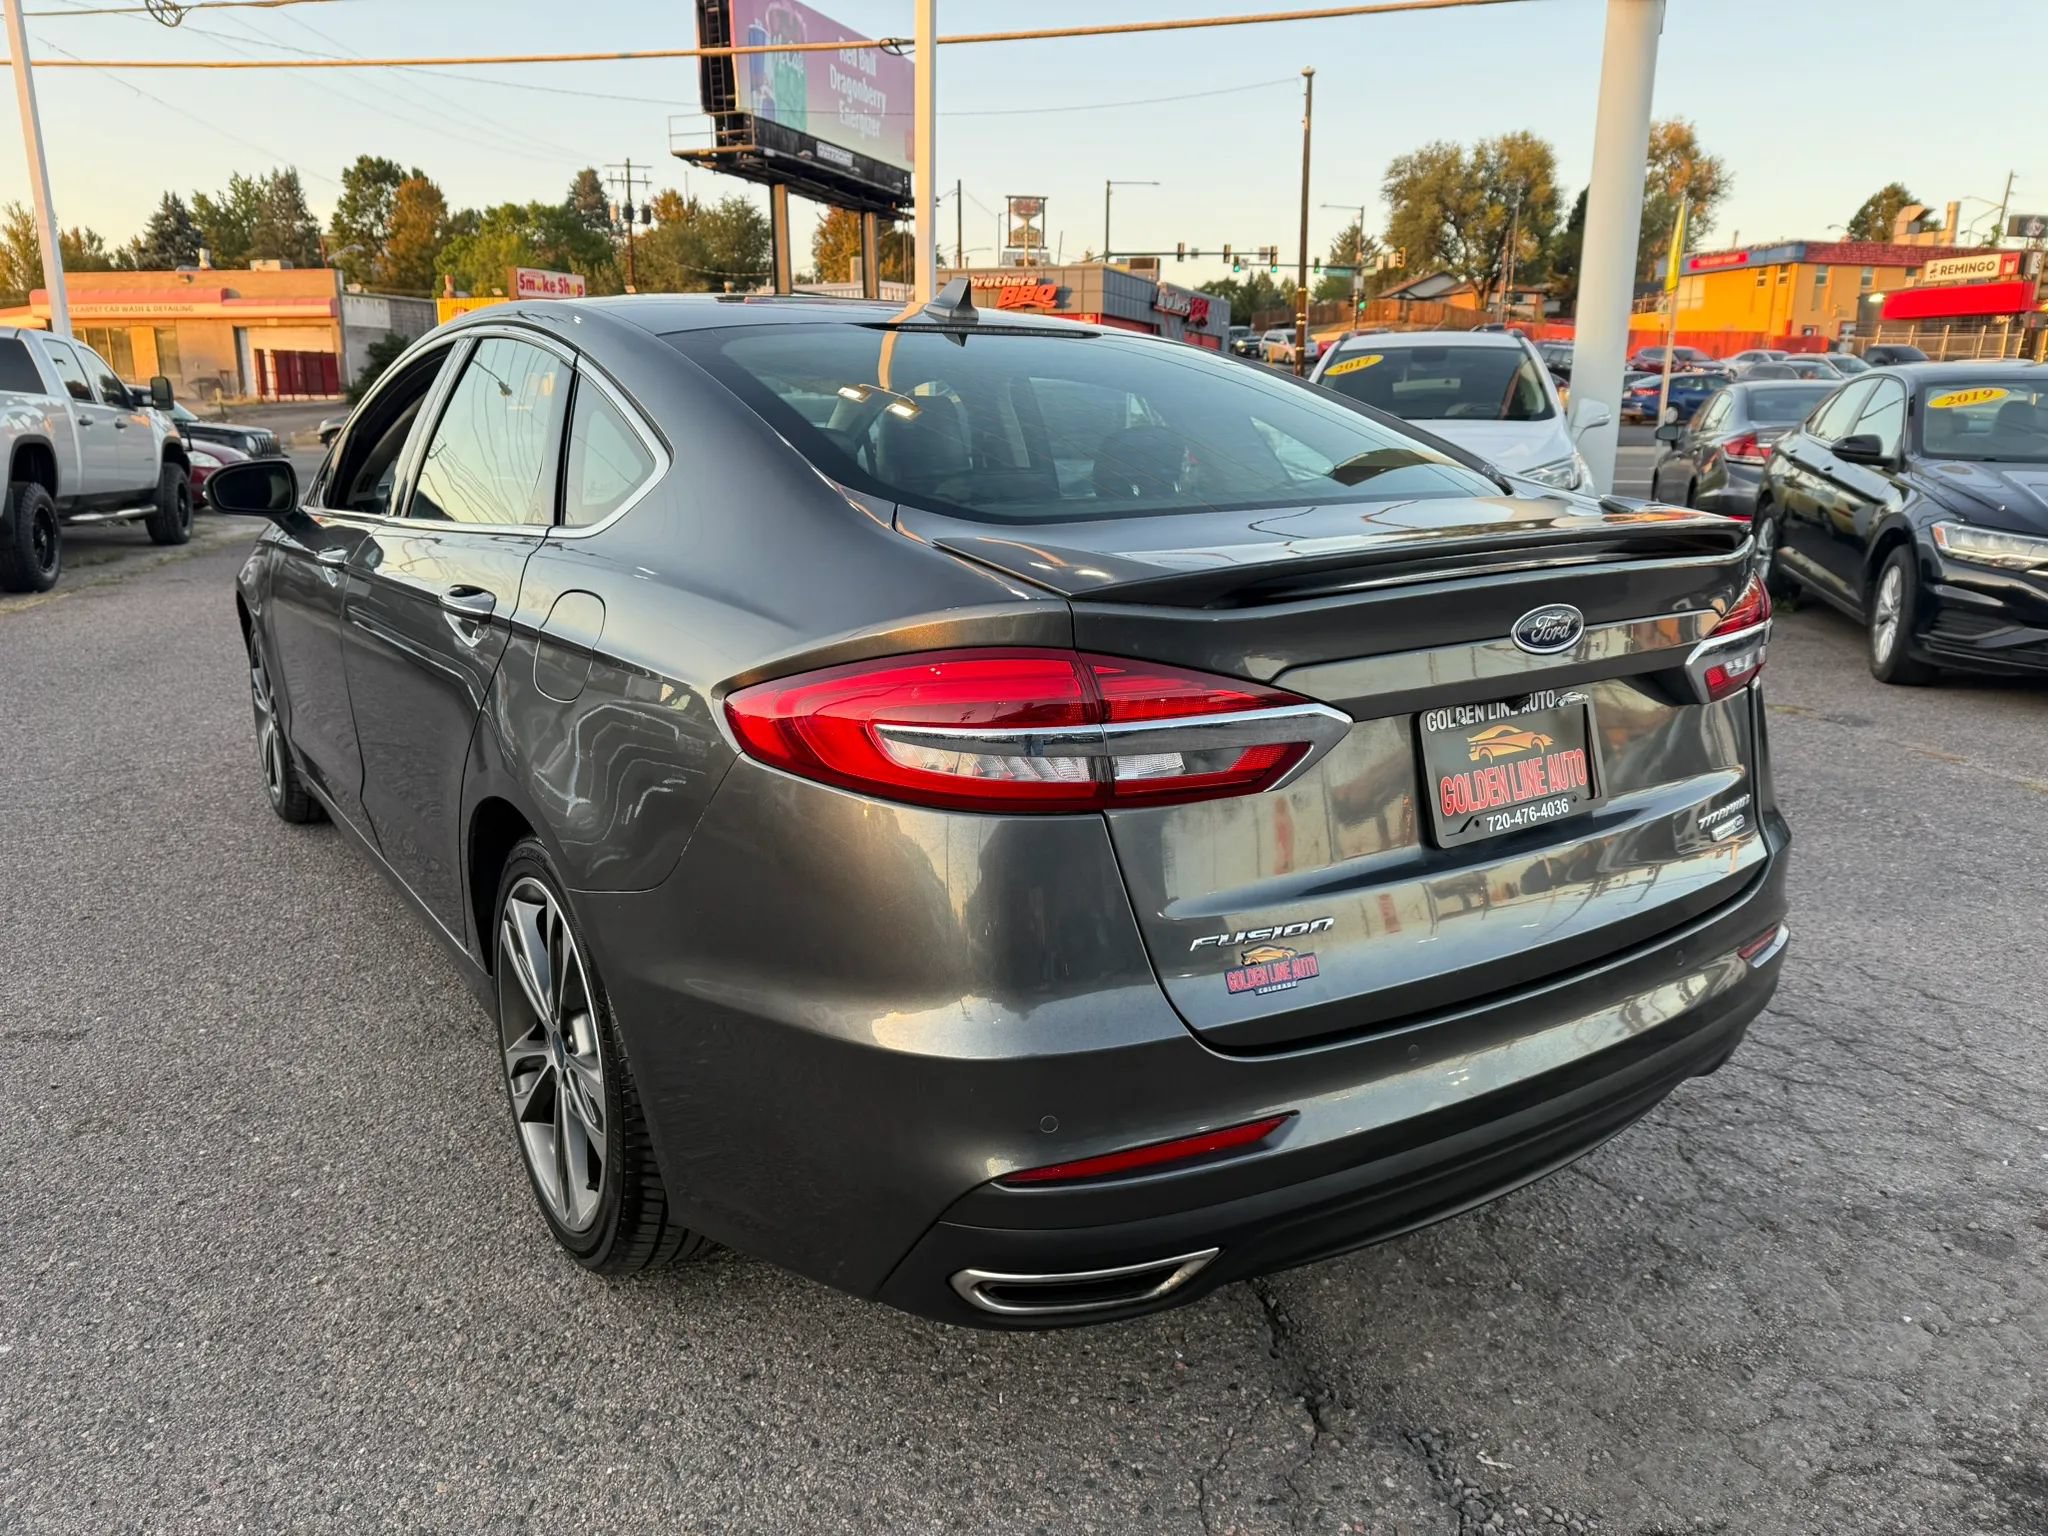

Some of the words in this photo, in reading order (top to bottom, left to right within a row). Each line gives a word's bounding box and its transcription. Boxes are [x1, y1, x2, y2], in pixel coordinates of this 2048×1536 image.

[829, 63, 887, 117] Dragonberry
[1939, 260, 1996, 276] REMINGO
[519, 272, 556, 294] Smoke
[558, 276, 584, 297] Shop
[996, 284, 1057, 309] BBQ
[122, 305, 145, 313] WASH
[153, 304, 195, 312] DETAILING
[1337, 356, 1371, 373] 2017
[1944, 389, 1994, 406] 2019
[1530, 614, 1577, 643] Ford
[1440, 762, 1512, 816] GOLDEN
[1509, 756, 1548, 801] LINE
[1547, 748, 1588, 793] AUTO
[1486, 797, 1569, 832] 720-476-4036
[1190, 916, 1336, 951] FUSION
[1227, 965, 1269, 992] GOLDEN
[1267, 960, 1292, 983] LINE
[1292, 955, 1318, 978] AUTO
[1258, 981, 1297, 994] COLORADO
